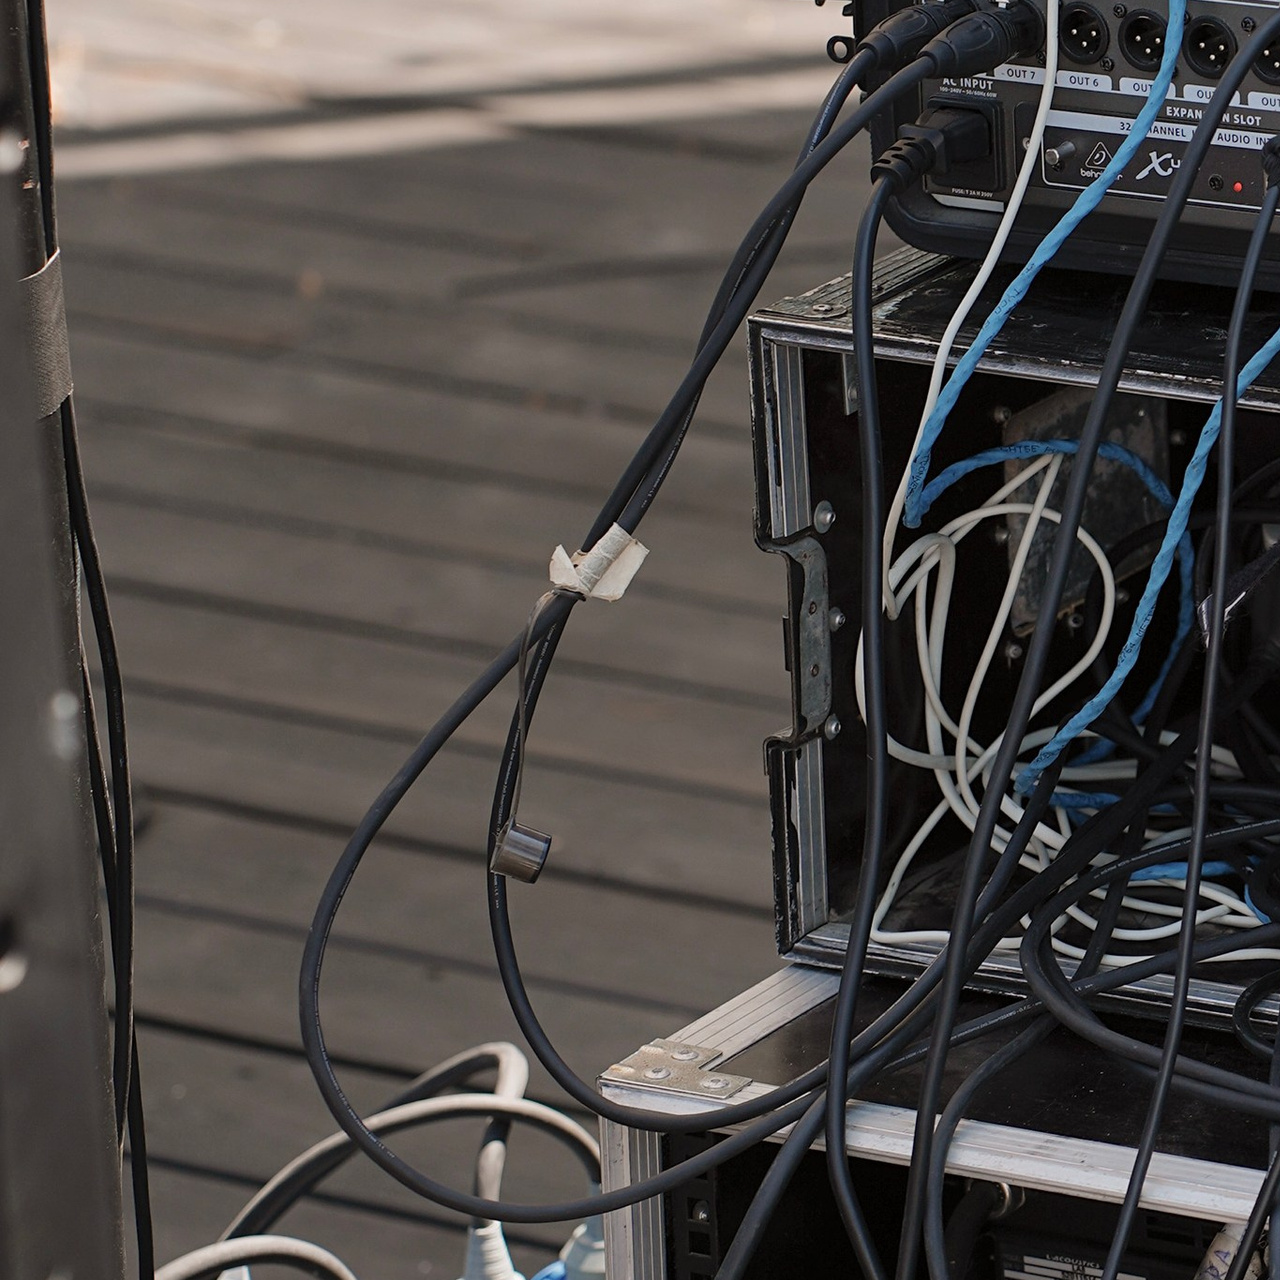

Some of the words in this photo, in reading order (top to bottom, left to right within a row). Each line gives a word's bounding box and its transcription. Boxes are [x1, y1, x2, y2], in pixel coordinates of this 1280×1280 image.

[1006, 68, 1027, 79] OUT
[1069, 75, 1089, 86] OUT
[942, 77, 957, 87] AC
[960, 78, 993, 91] INPUT
[1166, 106, 1229, 123] EXPANN
[1233, 112, 1262, 127] SLOT
[1119, 122, 1130, 131] 32
[1146, 124, 1186, 138] HANNEL
[1217, 132, 1250, 145] AUDIO
